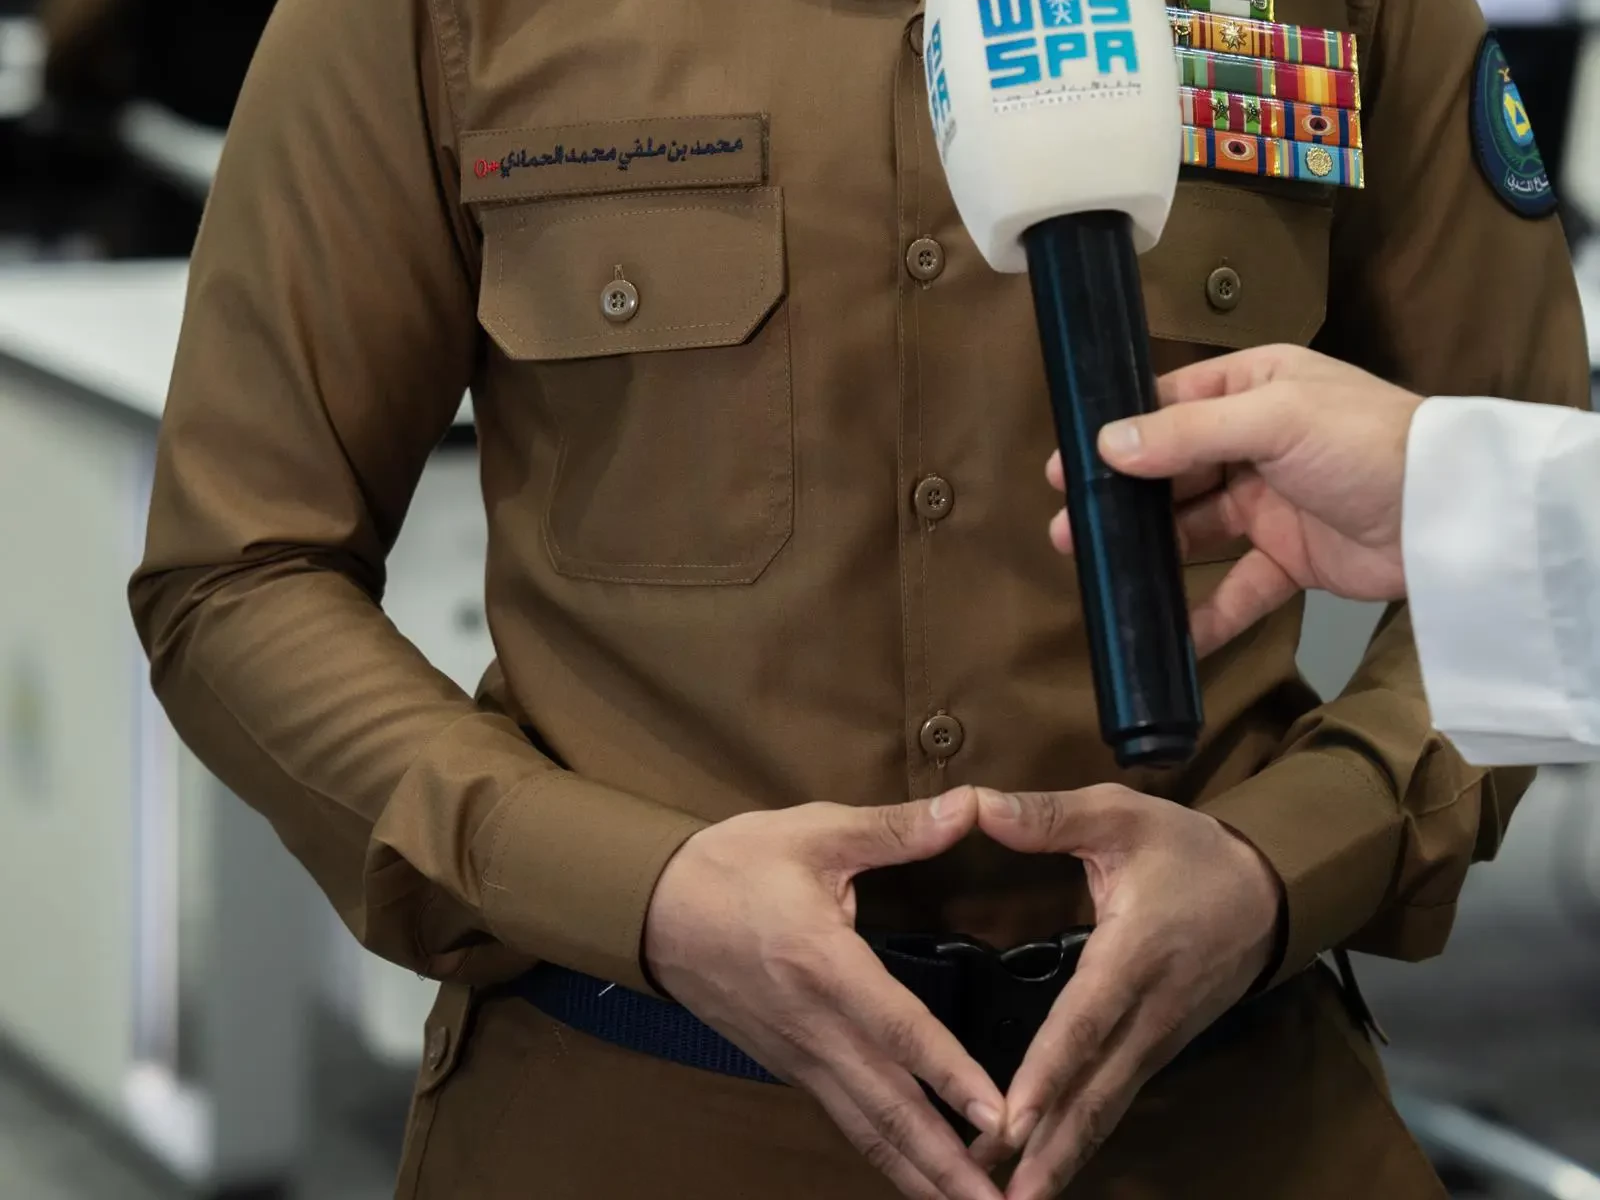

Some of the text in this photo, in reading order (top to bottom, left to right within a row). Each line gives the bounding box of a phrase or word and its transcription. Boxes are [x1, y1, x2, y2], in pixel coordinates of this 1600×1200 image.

[984, 30, 1140, 90] SPA
[565, 146, 617, 164] محمد
[667, 140, 689, 162] بن
[690, 136, 744, 156] محمد
